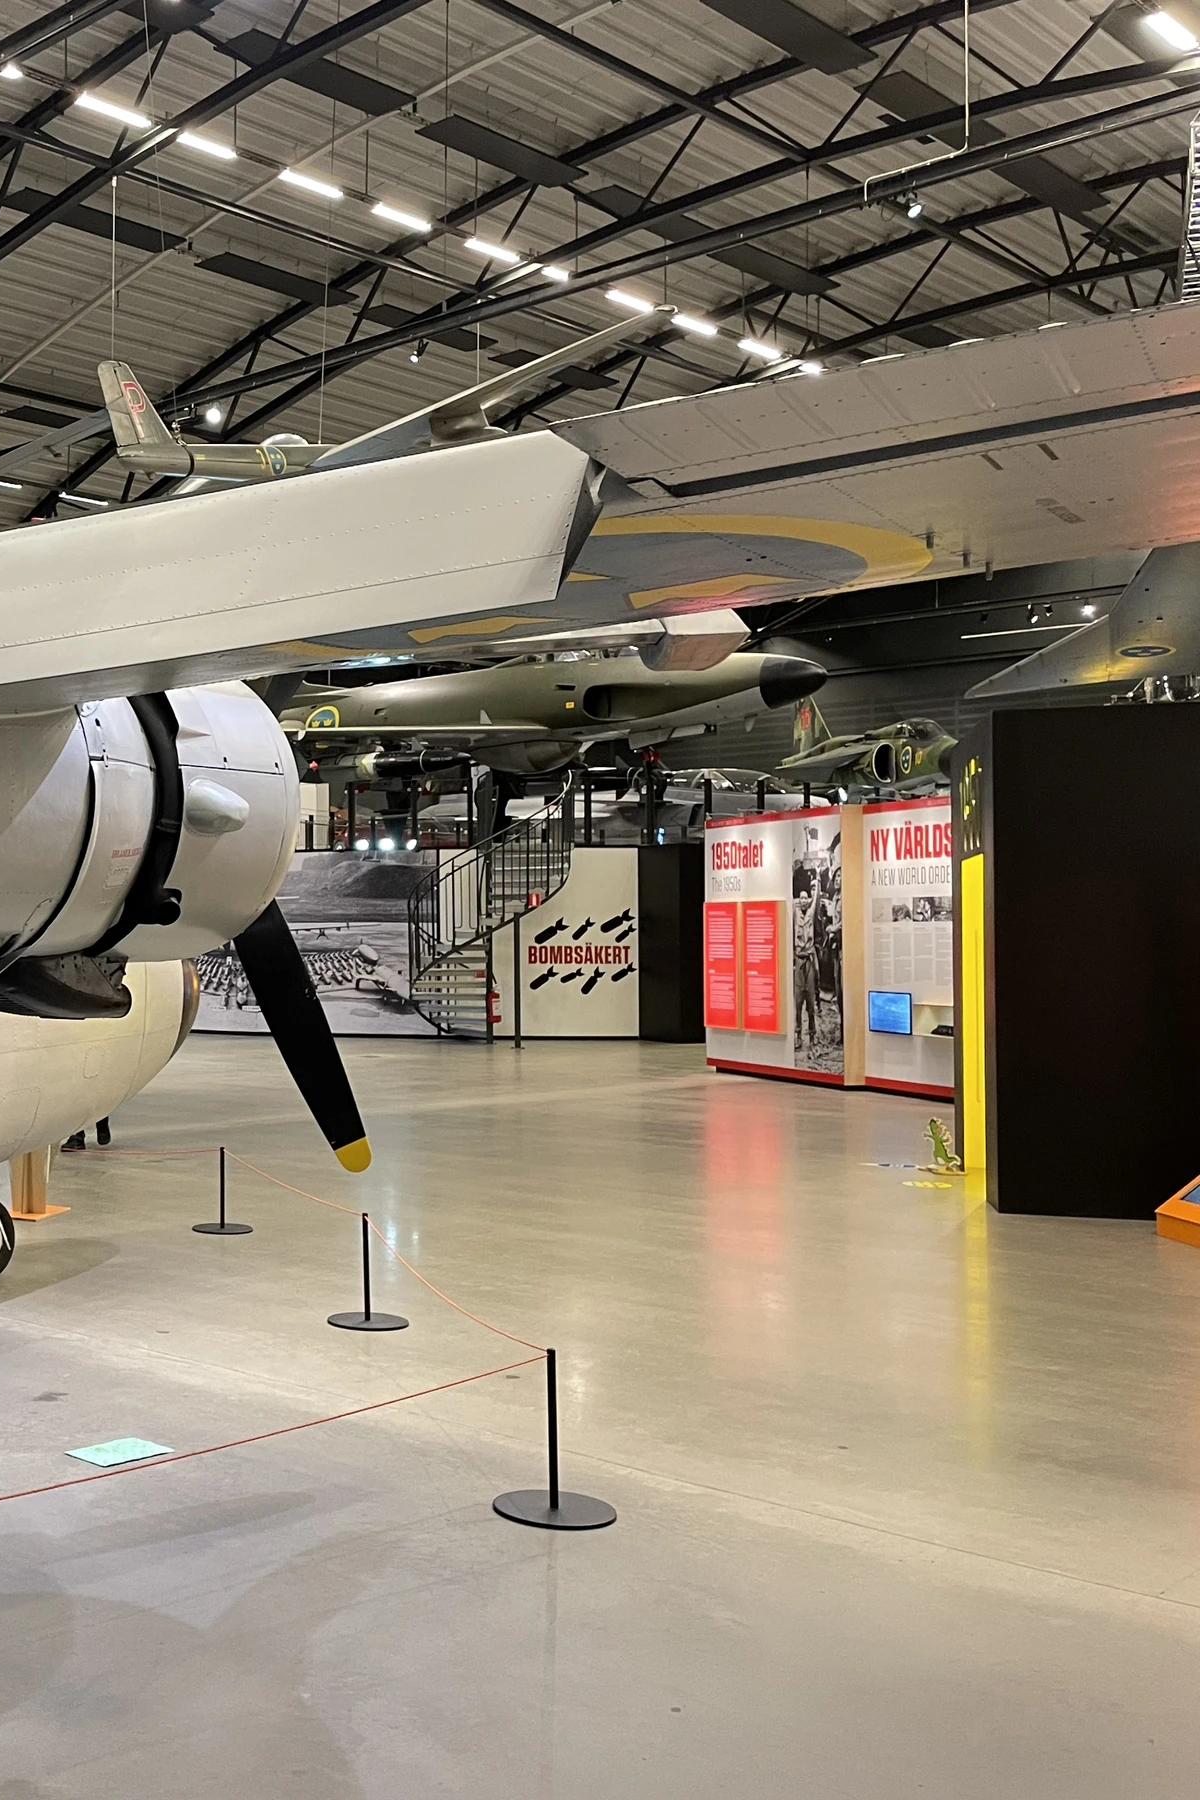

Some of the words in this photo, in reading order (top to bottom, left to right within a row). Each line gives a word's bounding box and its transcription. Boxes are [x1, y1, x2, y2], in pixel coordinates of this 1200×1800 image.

[121, 381, 146, 439] P
[711, 840, 764, 871] 1950talet
[870, 828, 892, 863] NY
[894, 821, 952, 862] VÄRLDS
[711, 876, 722, 892] The
[722, 875, 742, 892] 1950s
[871, 872, 877, 886] A
[878, 869, 896, 886] NEW
[897, 866, 927, 886] WORLD
[528, 942, 631, 965] BOMBSÄKERT
